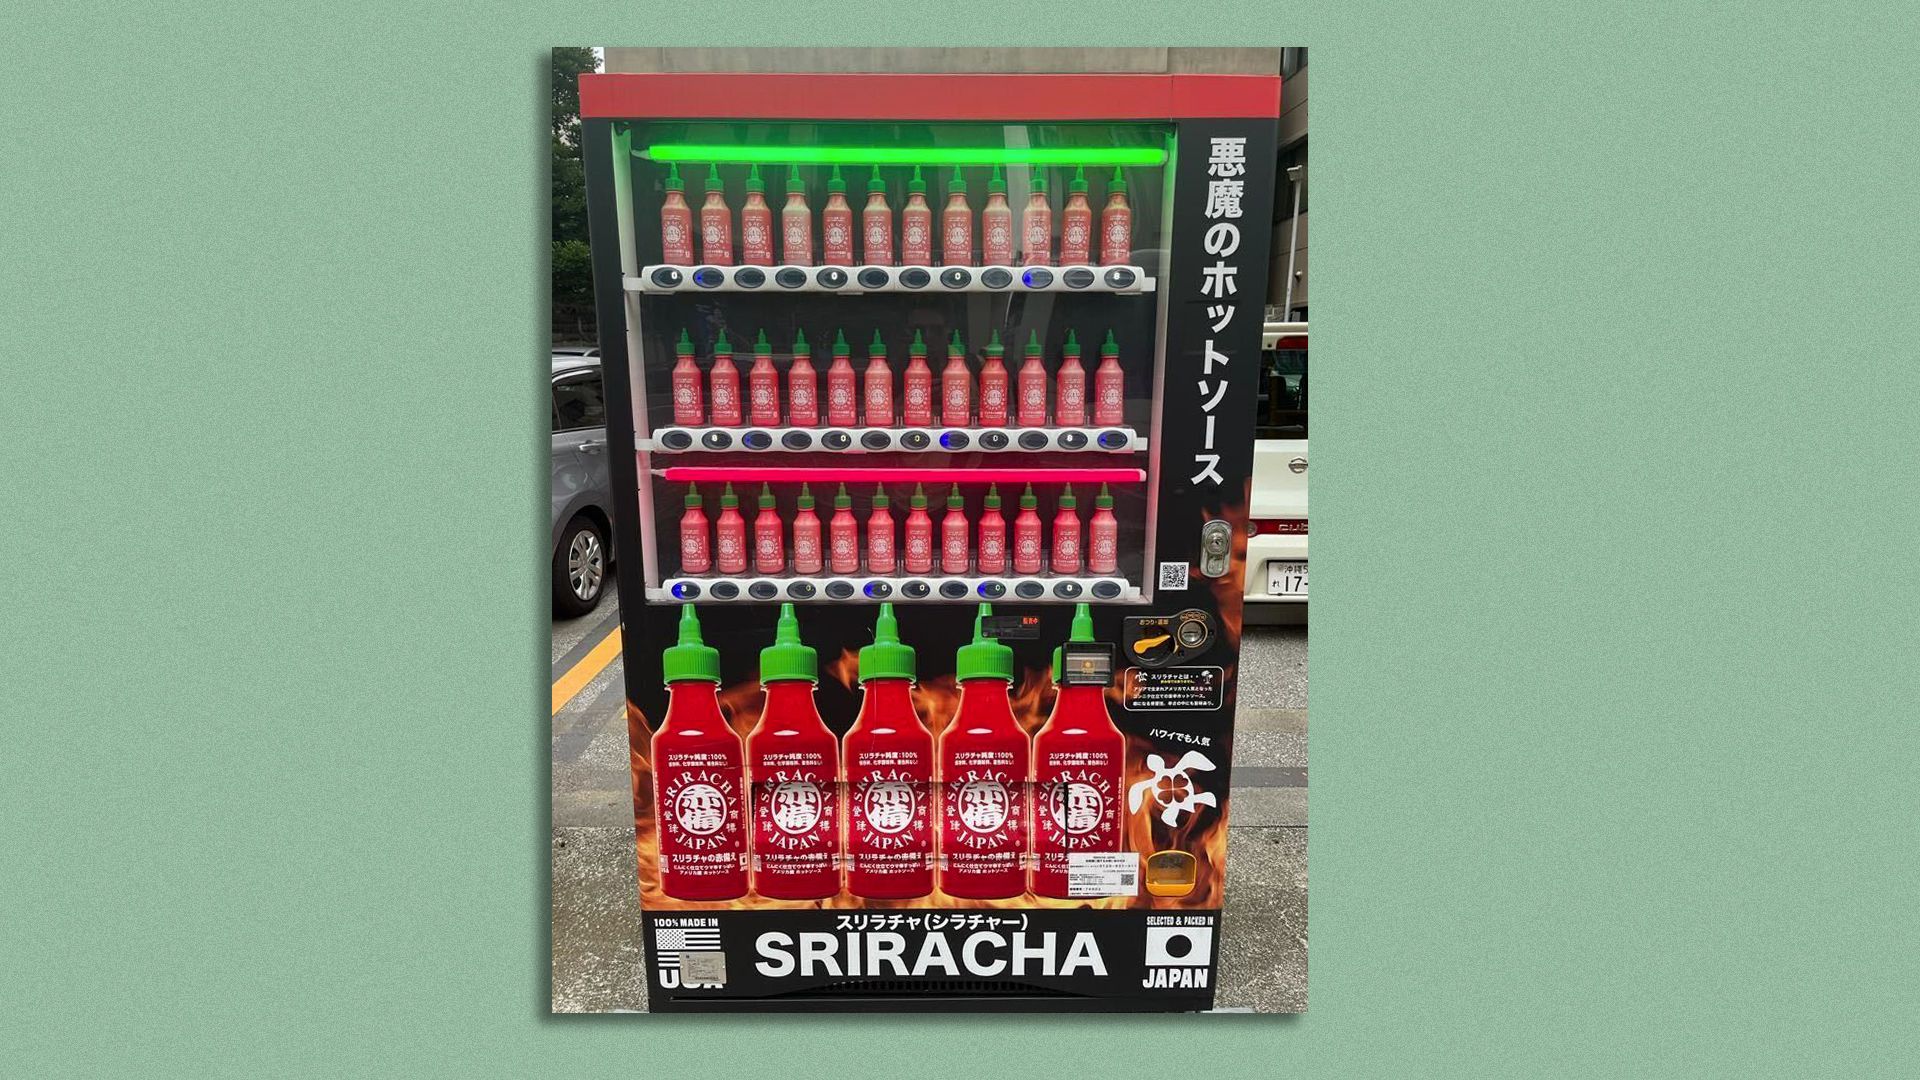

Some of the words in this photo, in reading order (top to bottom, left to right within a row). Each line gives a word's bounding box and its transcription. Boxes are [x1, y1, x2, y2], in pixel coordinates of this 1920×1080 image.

[1191, 137, 1247, 486] 悪魔のホットソース
[1149, 728, 1211, 746] ハワイでも人気
[664, 770, 736, 807] SRIRACHA
[675, 832, 727, 850] JAPAN
[769, 832, 821, 850] JAPAN
[862, 830, 914, 849] JAPAN
[957, 830, 1009, 849] JAPAN
[1049, 831, 1101, 849] JAPAN
[654, 918, 678, 927] 100%
[680, 918, 707, 927] MADE
[708, 918, 718, 927] IN
[836, 913, 1028, 931] スリラチャ(シラチャー)
[1146, 916, 1174, 925] SELECTED
[1176, 916, 1182, 925] &
[1184, 916, 1206, 925] PACKED
[1207, 916, 1214, 925] IN
[754, 930, 1108, 977] SRIRACHA
[1142, 968, 1209, 989] JAPAN
